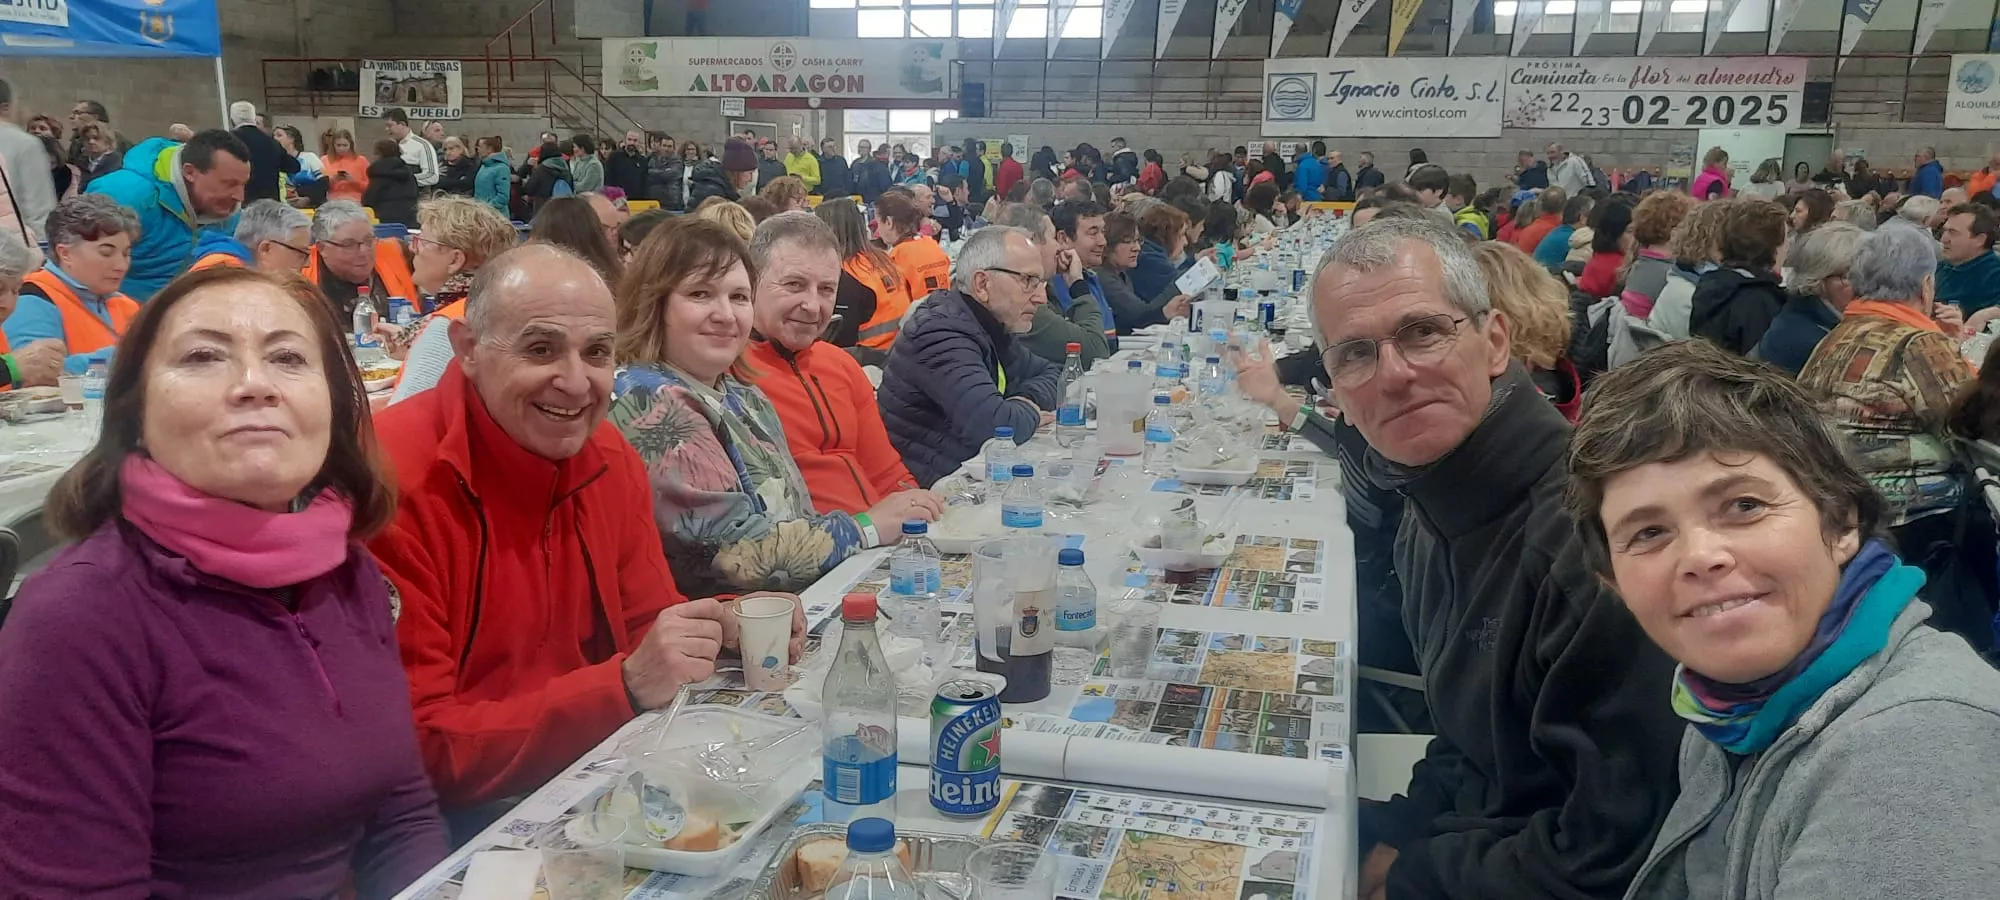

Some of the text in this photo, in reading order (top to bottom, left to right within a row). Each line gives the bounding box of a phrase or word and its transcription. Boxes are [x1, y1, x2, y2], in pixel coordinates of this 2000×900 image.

[363, 60, 375, 70] LA
[378, 61, 408, 71] VIRGEN
[409, 61, 421, 71] DE
[688, 57, 864, 67] SUPERMERCADOS CASH & CARRY
[688, 67, 865, 93] ALTOARAGÓN
[1324, 70, 1400, 105] Ignacio
[1410, 74, 1459, 101] Cinto,
[1510, 68, 1598, 85] Caminata
[1628, 65, 1672, 90] flor
[1694, 66, 1795, 86] almendro
[361, 105, 378, 116] ES
[410, 107, 460, 118] PUEBLO
[1550, 92, 1580, 112] 22
[1355, 106, 1468, 119] www.cintosl.com
[940, 701, 999, 761] HEINEKEN
